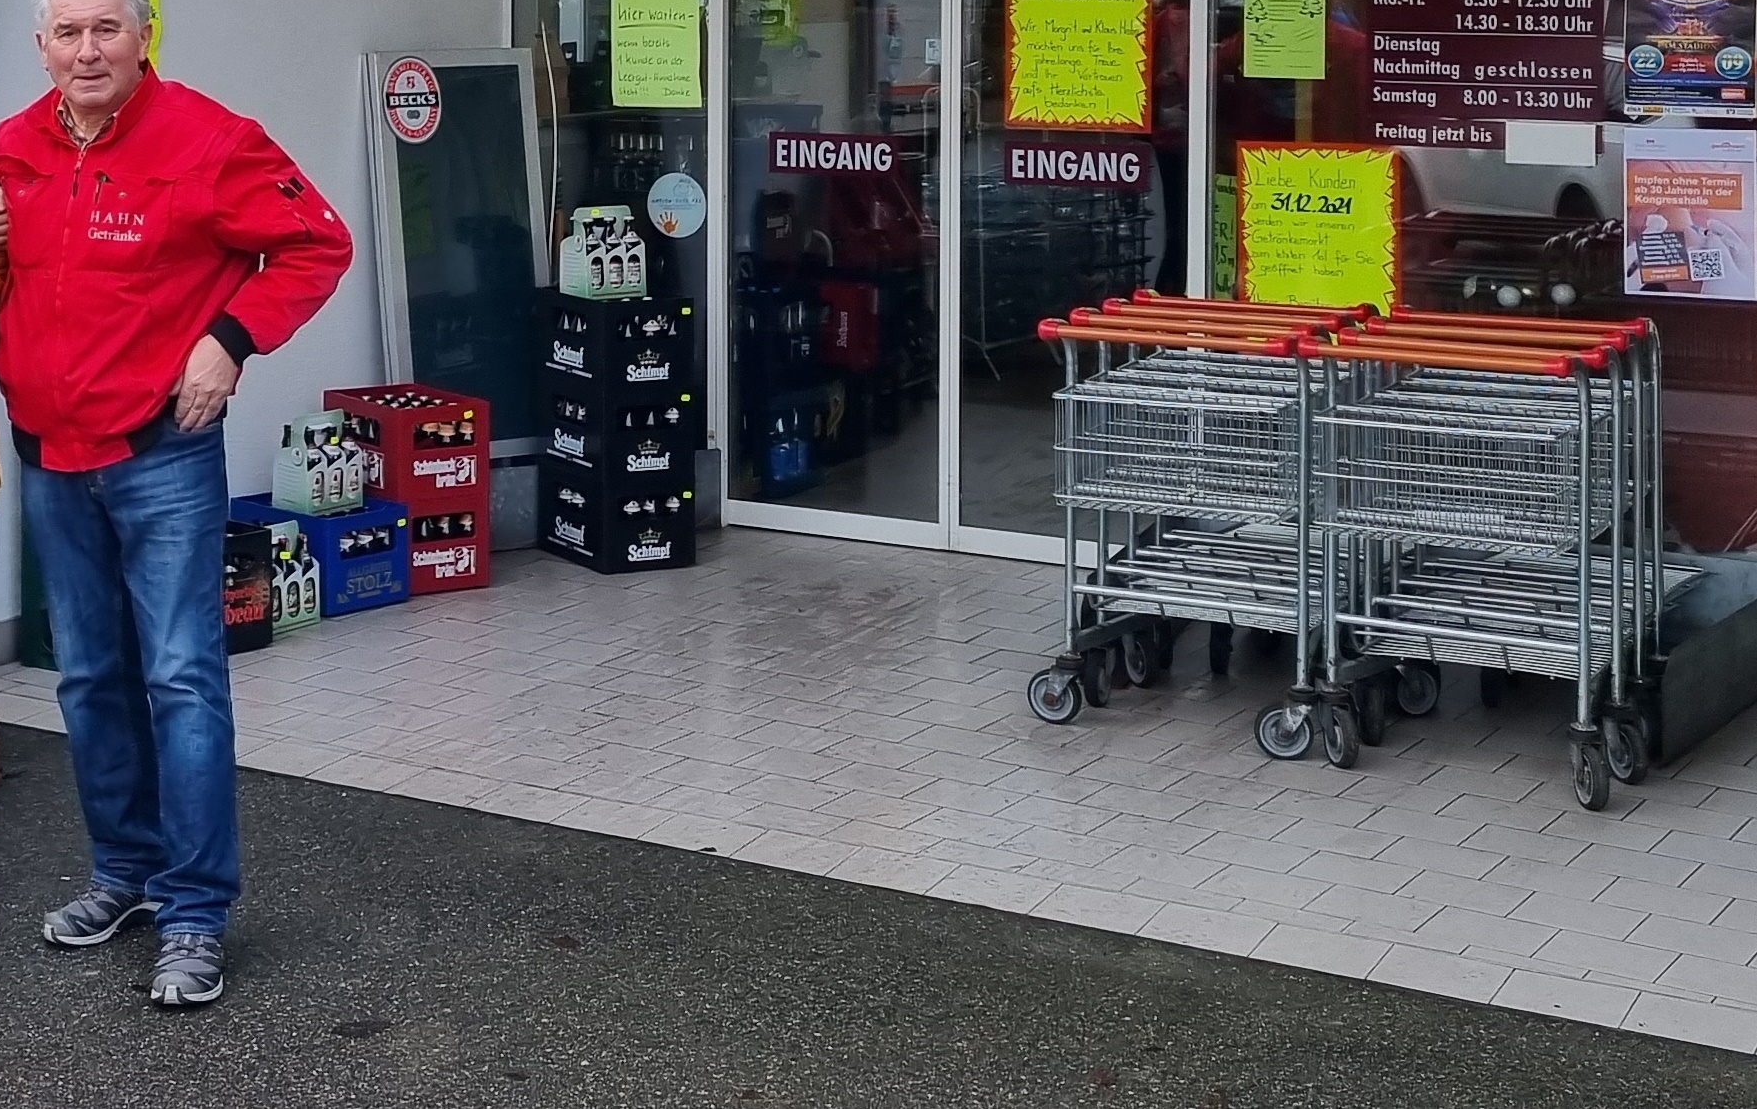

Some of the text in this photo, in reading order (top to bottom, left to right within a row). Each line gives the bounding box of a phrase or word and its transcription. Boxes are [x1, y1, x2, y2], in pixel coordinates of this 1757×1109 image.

[1455, 13, 1498, 30] 14.30
[1516, 14, 1560, 31] 18.30
[1564, 15, 1594, 32] Uhr
[1373, 35, 1441, 56] Dienstag
[1373, 57, 1593, 81] Nachmittag geschlossen
[388, 93, 437, 106] BECK'S
[1373, 86, 1437, 108] Samstag
[1463, 89, 1498, 106] 8.00
[1515, 90, 1559, 108] 13.30
[1563, 91, 1594, 109] Uhr
[1375, 122, 1493, 144] Freitag jetzt bis
[776, 138, 893, 172] EINGANG
[1011, 149, 1141, 183] EINGANG
[1255, 166, 1296, 188] Liebe
[1634, 175, 1737, 187] Impfen ohne Termin
[1634, 185, 1733, 197] ab 30 Jahren in der
[1634, 195, 1709, 206] Kongresshalle
[1270, 192, 1353, 214] 31.12.2021
[89, 210, 145, 227] HAHN
[87, 224, 142, 243] Getränke
[626, 362, 671, 382] Schimpf
[626, 452, 671, 472] Schimpf
[627, 541, 672, 562] Schimpf
[346, 571, 393, 595] STOLZ
